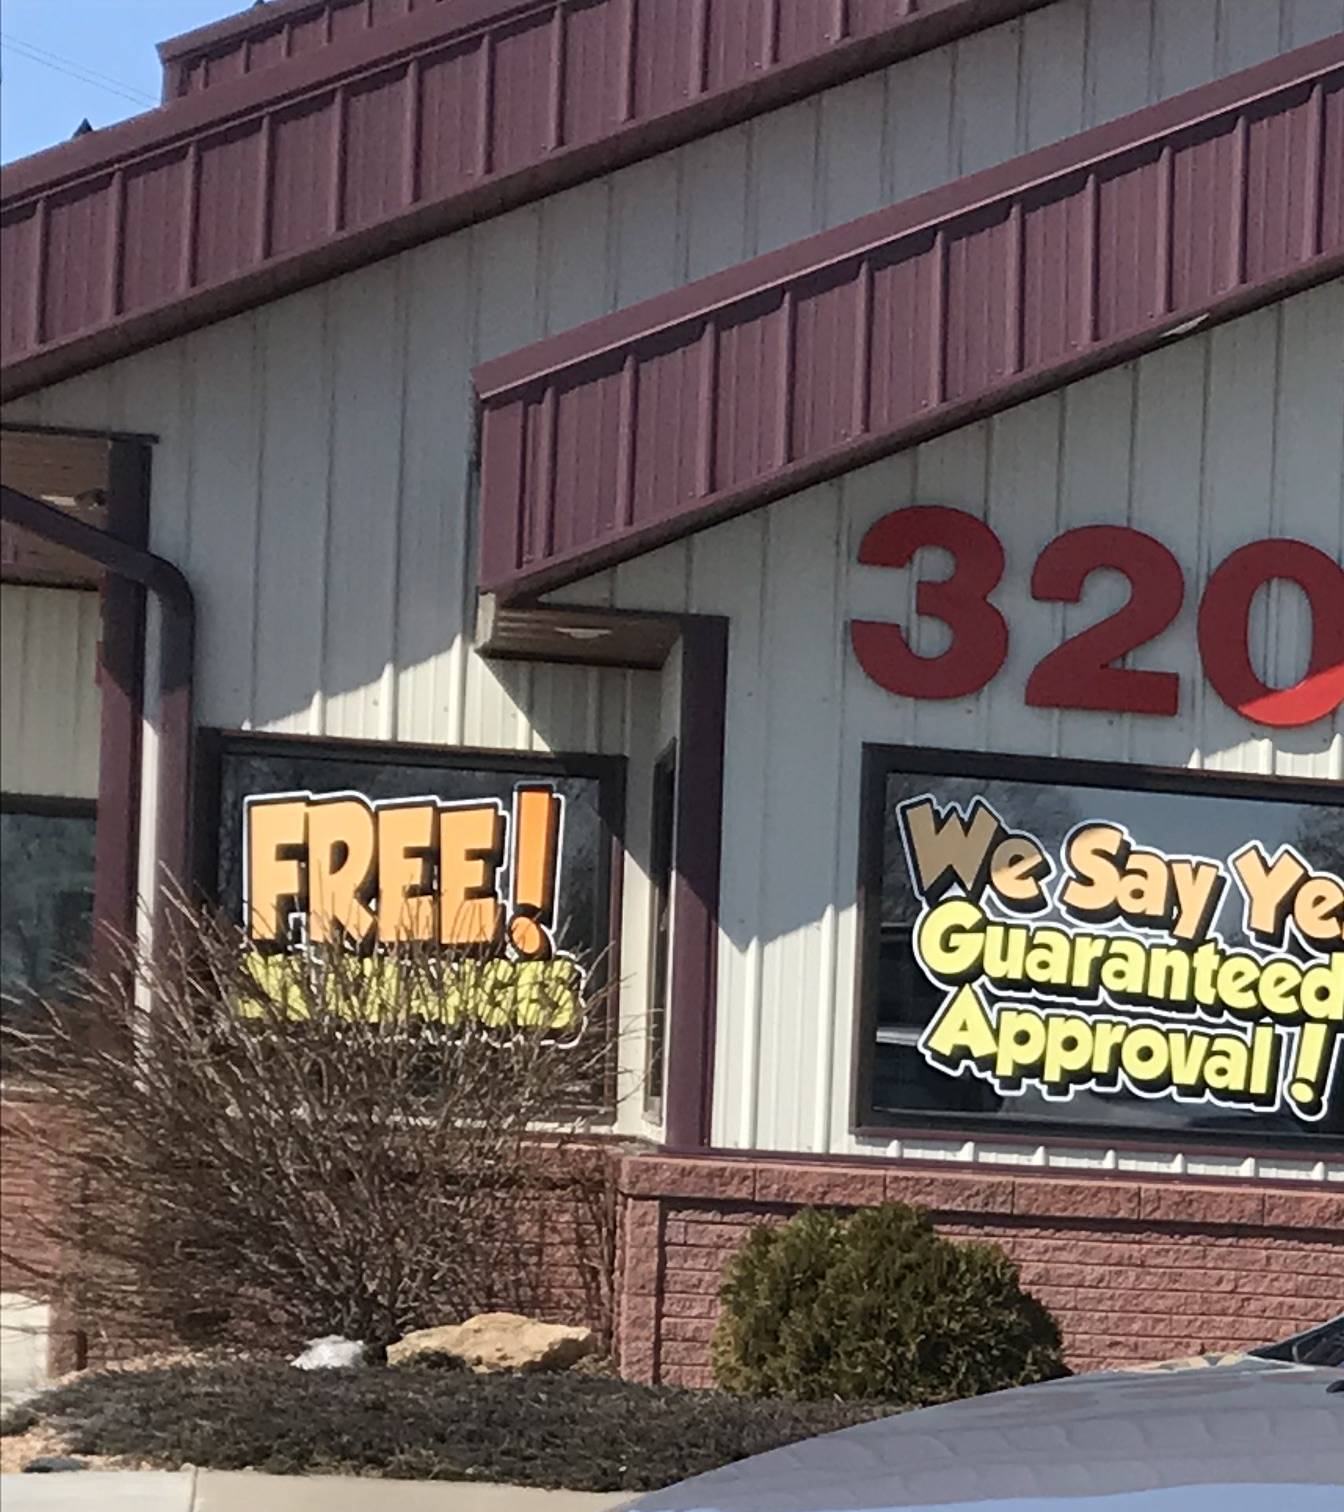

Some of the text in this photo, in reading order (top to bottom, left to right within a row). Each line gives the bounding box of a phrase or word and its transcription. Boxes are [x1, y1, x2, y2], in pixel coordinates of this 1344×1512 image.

[250, 788, 552, 955] FREE!
[905, 799, 1049, 900] We
[1063, 826, 1221, 939] Say
